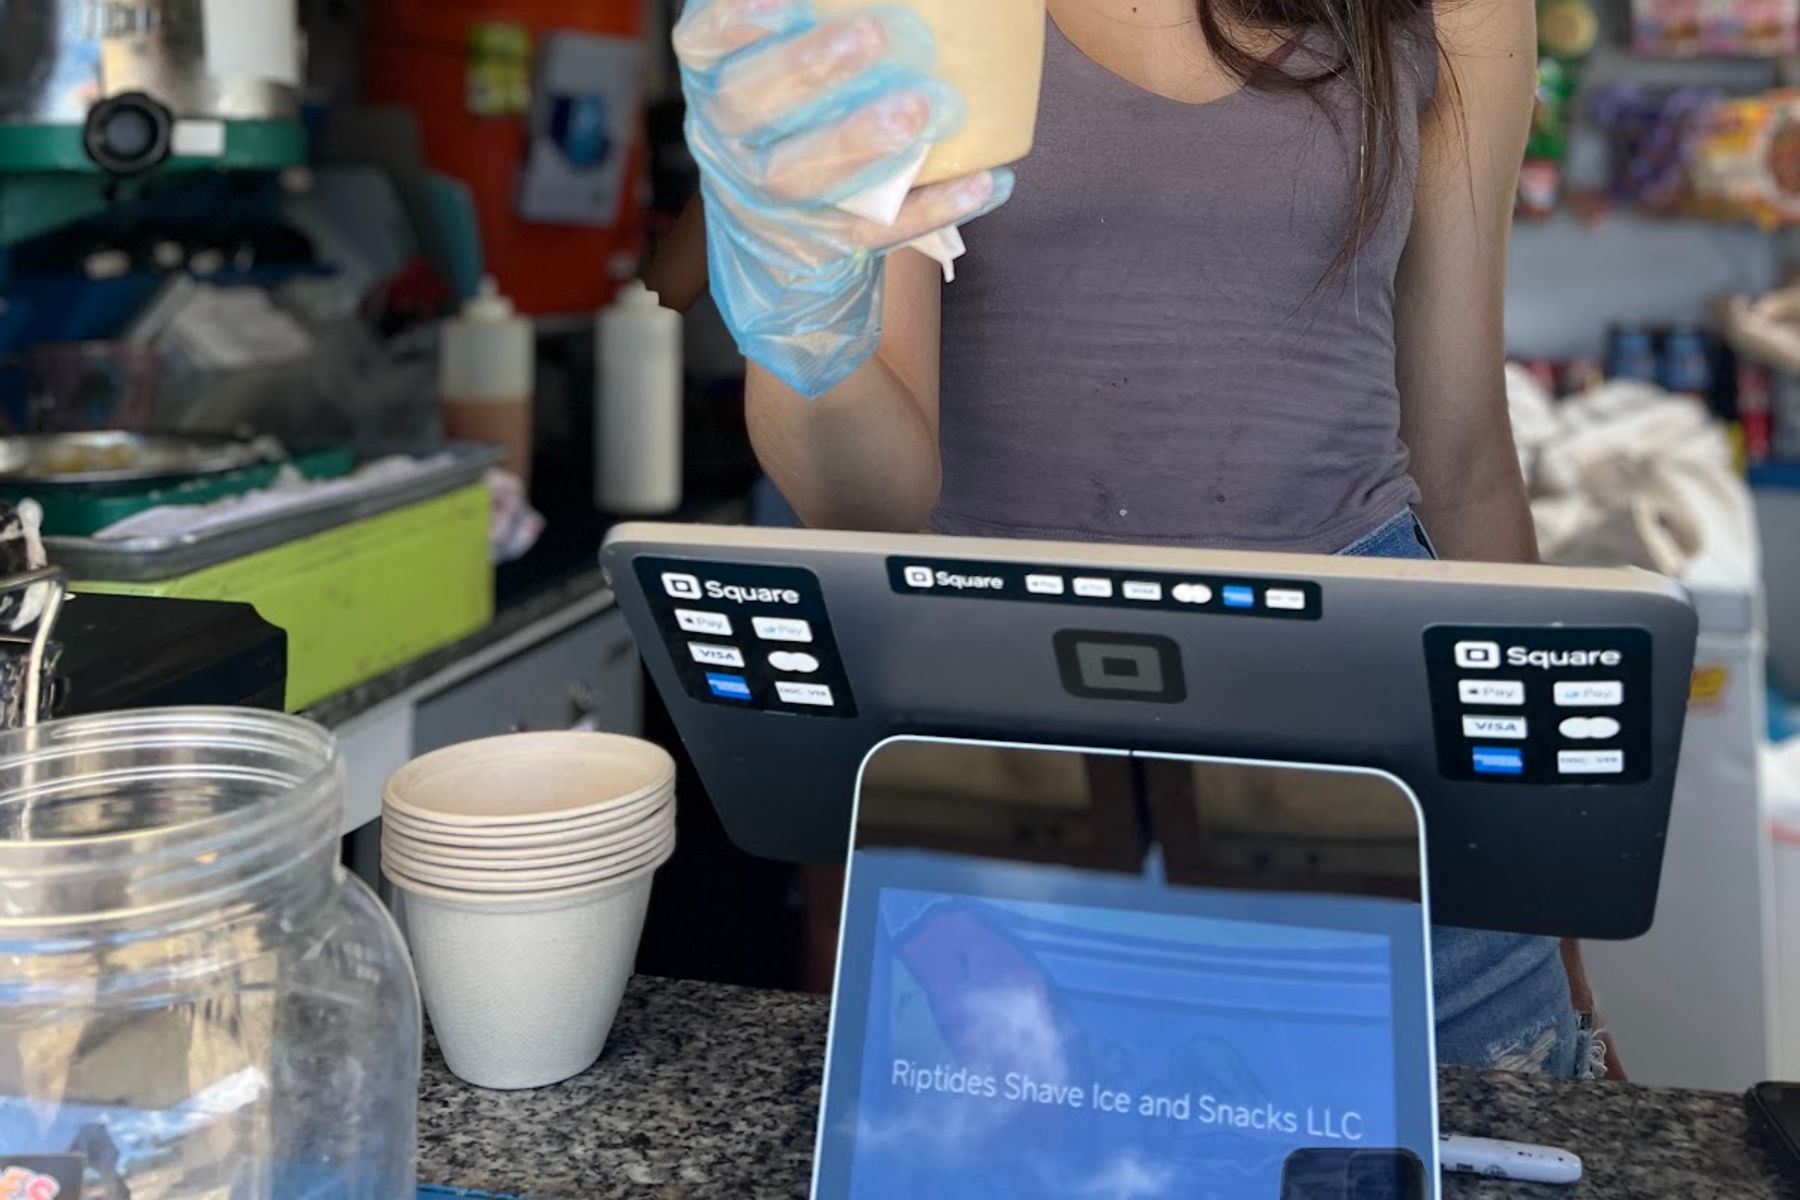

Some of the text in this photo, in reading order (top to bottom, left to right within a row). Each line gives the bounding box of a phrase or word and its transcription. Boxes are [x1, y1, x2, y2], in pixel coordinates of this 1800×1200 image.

[935, 570, 1004, 590] Square
[704, 579, 800, 604] Square
[700, 649, 735, 660] VISA
[1506, 646, 1622, 669] Square
[1474, 721, 1517, 732] VISA
[891, 1059, 1363, 1140] Riptides Shave Ice and Snacks LLC
